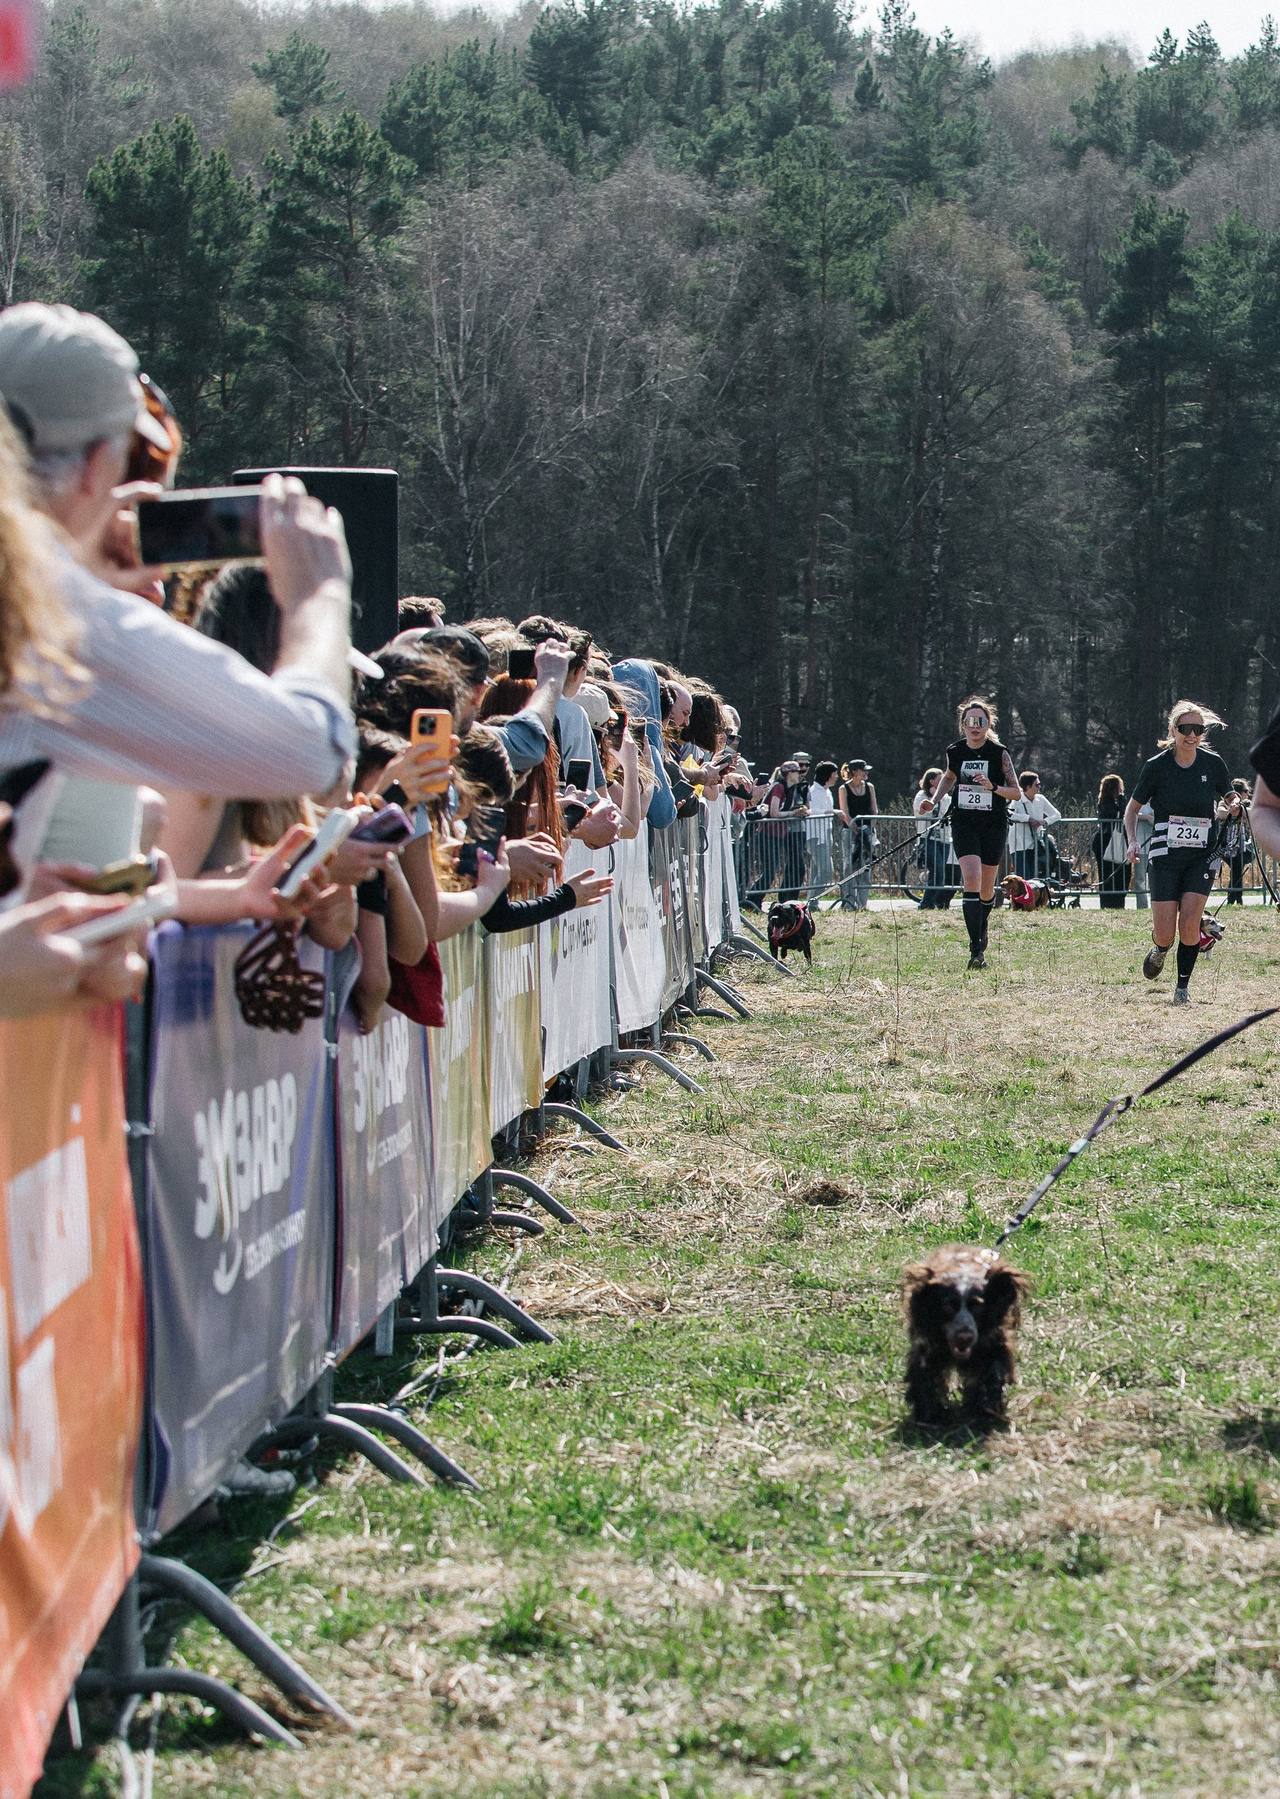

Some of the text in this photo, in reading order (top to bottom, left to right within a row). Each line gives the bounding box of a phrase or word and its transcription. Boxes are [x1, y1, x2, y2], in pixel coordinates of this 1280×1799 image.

[964, 762, 985, 770] ROCKY
[968, 794, 981, 804] 28
[1177, 827, 1200, 840] 234
